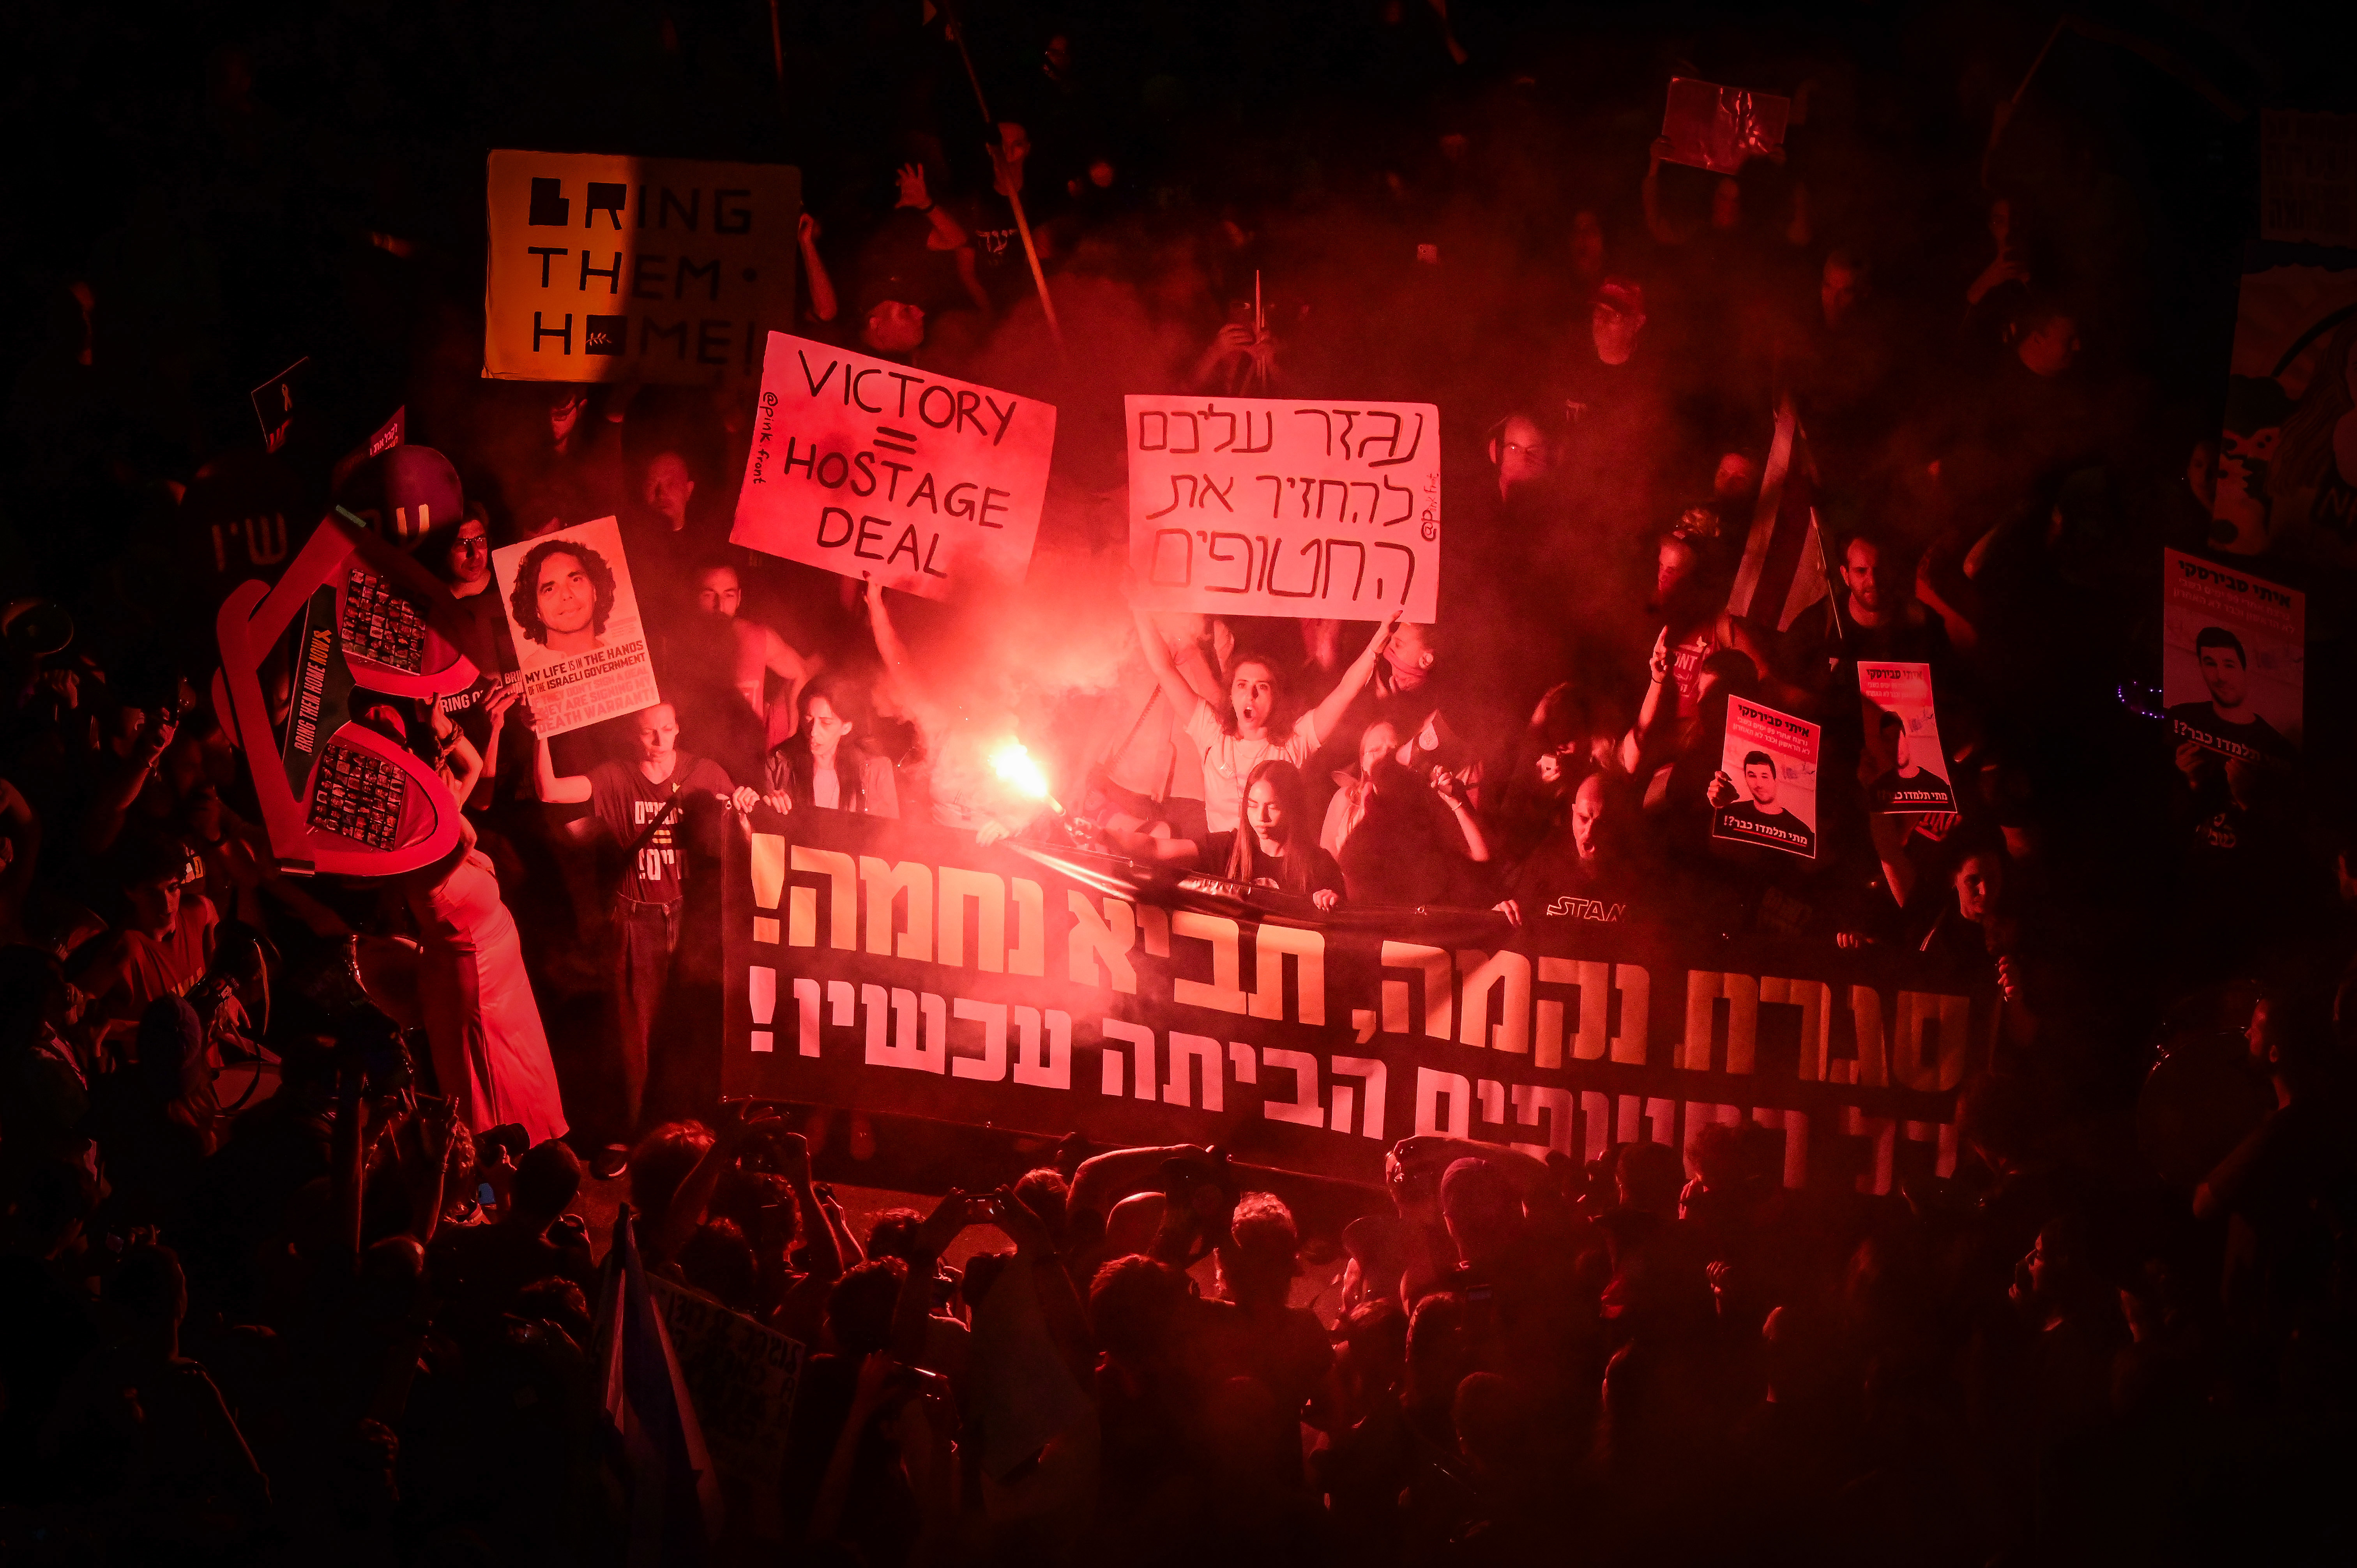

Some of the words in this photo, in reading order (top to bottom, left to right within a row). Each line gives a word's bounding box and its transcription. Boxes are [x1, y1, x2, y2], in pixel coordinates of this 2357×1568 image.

[528, 177, 751, 234] BRING
[528, 247, 720, 300] THEM
[798, 350, 1016, 446] VICTORY
[1140, 403, 1273, 454] עליכם
[1294, 409, 1423, 467] נגזר
[784, 437, 1011, 528] HOSTAGE
[1146, 474, 1234, 520] את
[1256, 475, 1413, 526] להחזיר
[816, 507, 947, 579] DEAL
[1150, 528, 1415, 605] החטופים
[2178, 560, 2249, 592] סבירסקי
[2253, 585, 2291, 608] איתי
[309, 637, 329, 666] NOW
[525, 671, 541, 683] MY
[543, 662, 567, 678] LIFE
[568, 660, 575, 671] IS
[576, 658, 583, 669] IN
[584, 651, 605, 666] THE
[607, 640, 644, 659] HANDS
[304, 662, 325, 694] HOME
[528, 685, 535, 696] OF
[535, 682, 546, 693] THE
[547, 671, 583, 690] ISRAELI
[584, 652, 645, 679] GOVERNMENT
[566, 694, 588, 711] ARE
[590, 681, 634, 702] SIGNING
[636, 675, 651, 689] MY
[594, 675, 615, 689] SIGN
[617, 672, 624, 681] A
[624, 665, 649, 678] DEAL
[1866, 669, 1901, 680] סבירסקי
[299, 691, 320, 721] THEM
[440, 694, 470, 712] RING
[537, 709, 582, 734] DEATH
[583, 686, 656, 719] WARRANT!
[1738, 704, 1783, 727] סבירסקי
[294, 719, 316, 754] BRING
[1785, 721, 1809, 737] איתי
[1904, 790, 1930, 800] תלמדו
[1724, 815, 1753, 829] כבר?!
[1755, 824, 1786, 838] תלמדו
[1788, 833, 1807, 844] מתי
[751, 833, 1044, 977] נחמה!
[1067, 889, 1325, 1026] תביא
[1352, 940, 1650, 1069] נקמה,
[749, 966, 1072, 1089] עכשיו!
[1673, 969, 1970, 1091] סגרת
[1102, 1017, 1387, 1141] הביתה
